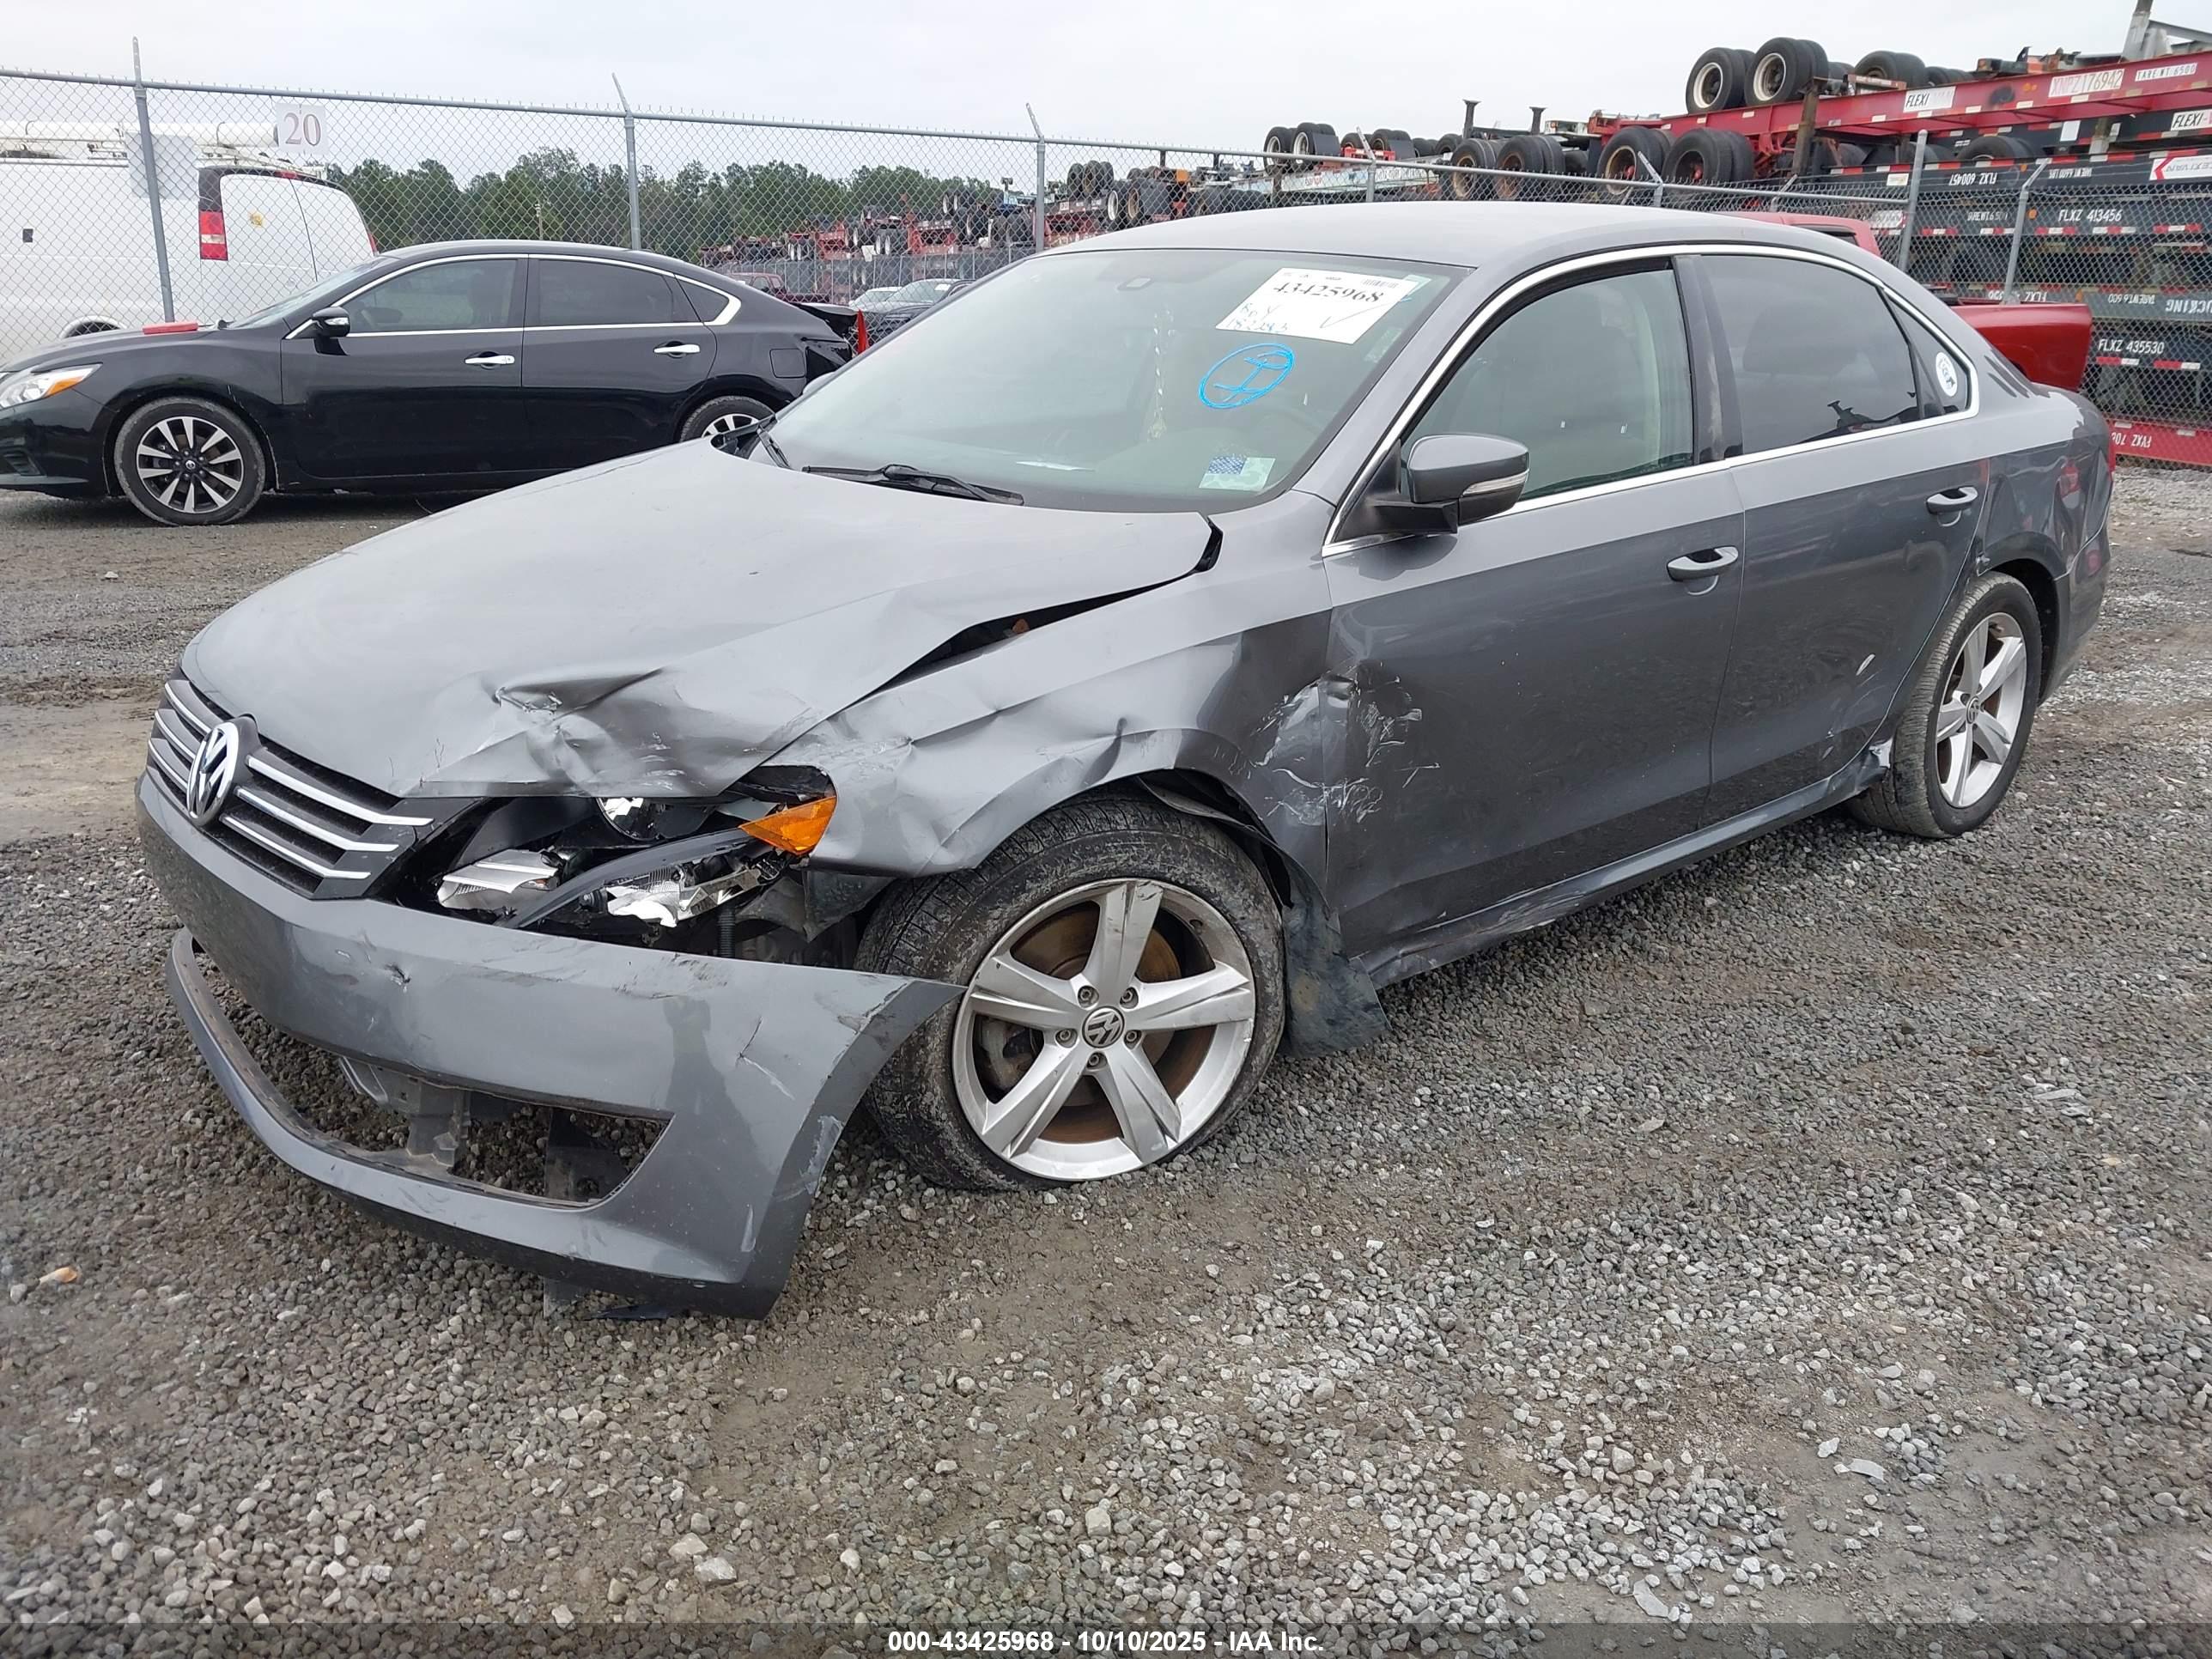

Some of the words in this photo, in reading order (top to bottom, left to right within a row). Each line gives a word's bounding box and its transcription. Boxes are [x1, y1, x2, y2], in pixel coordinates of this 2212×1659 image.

[1905, 93, 1929, 107] FLEXI
[283, 112, 321, 146] 20
[1948, 173, 1976, 186] 600457
[1979, 173, 1997, 185] FLXZ
[2058, 209, 2083, 222] FLXZ
[2087, 209, 2123, 222] 413456
[1273, 283, 1384, 303] 43425968
[2098, 338, 2123, 352] FLXZ
[2126, 339, 2164, 355] 435530
